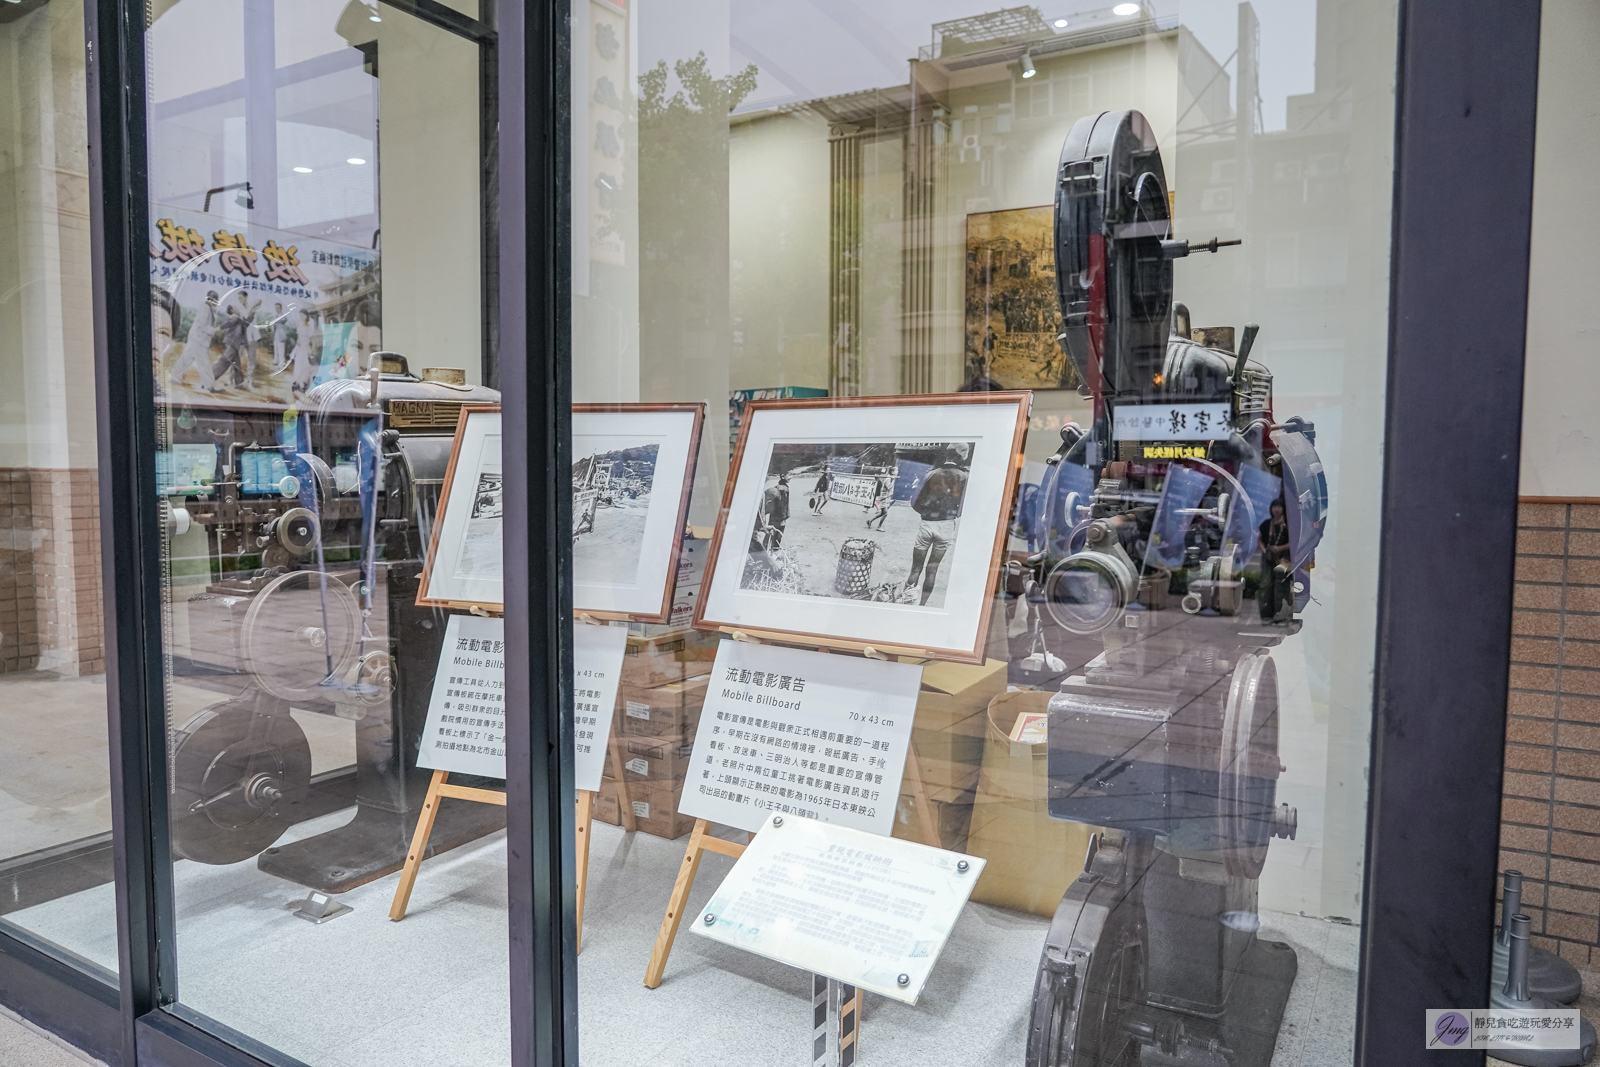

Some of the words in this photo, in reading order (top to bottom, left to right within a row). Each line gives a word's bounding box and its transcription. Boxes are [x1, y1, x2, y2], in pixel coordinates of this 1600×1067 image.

[454, 656, 483, 668] Mobile
[594, 671, 605, 679] cm
[725, 667, 806, 693] 流動電影廣告
[446, 689, 506, 702] 宣傳板綁在摩托車
[574, 702, 599, 713] 廣播宣
[722, 689, 753, 703] Mobile
[756, 694, 801, 711] Billboard
[849, 711, 859, 721] 70
[869, 715, 879, 725] 43
[881, 719, 894, 727] cm
